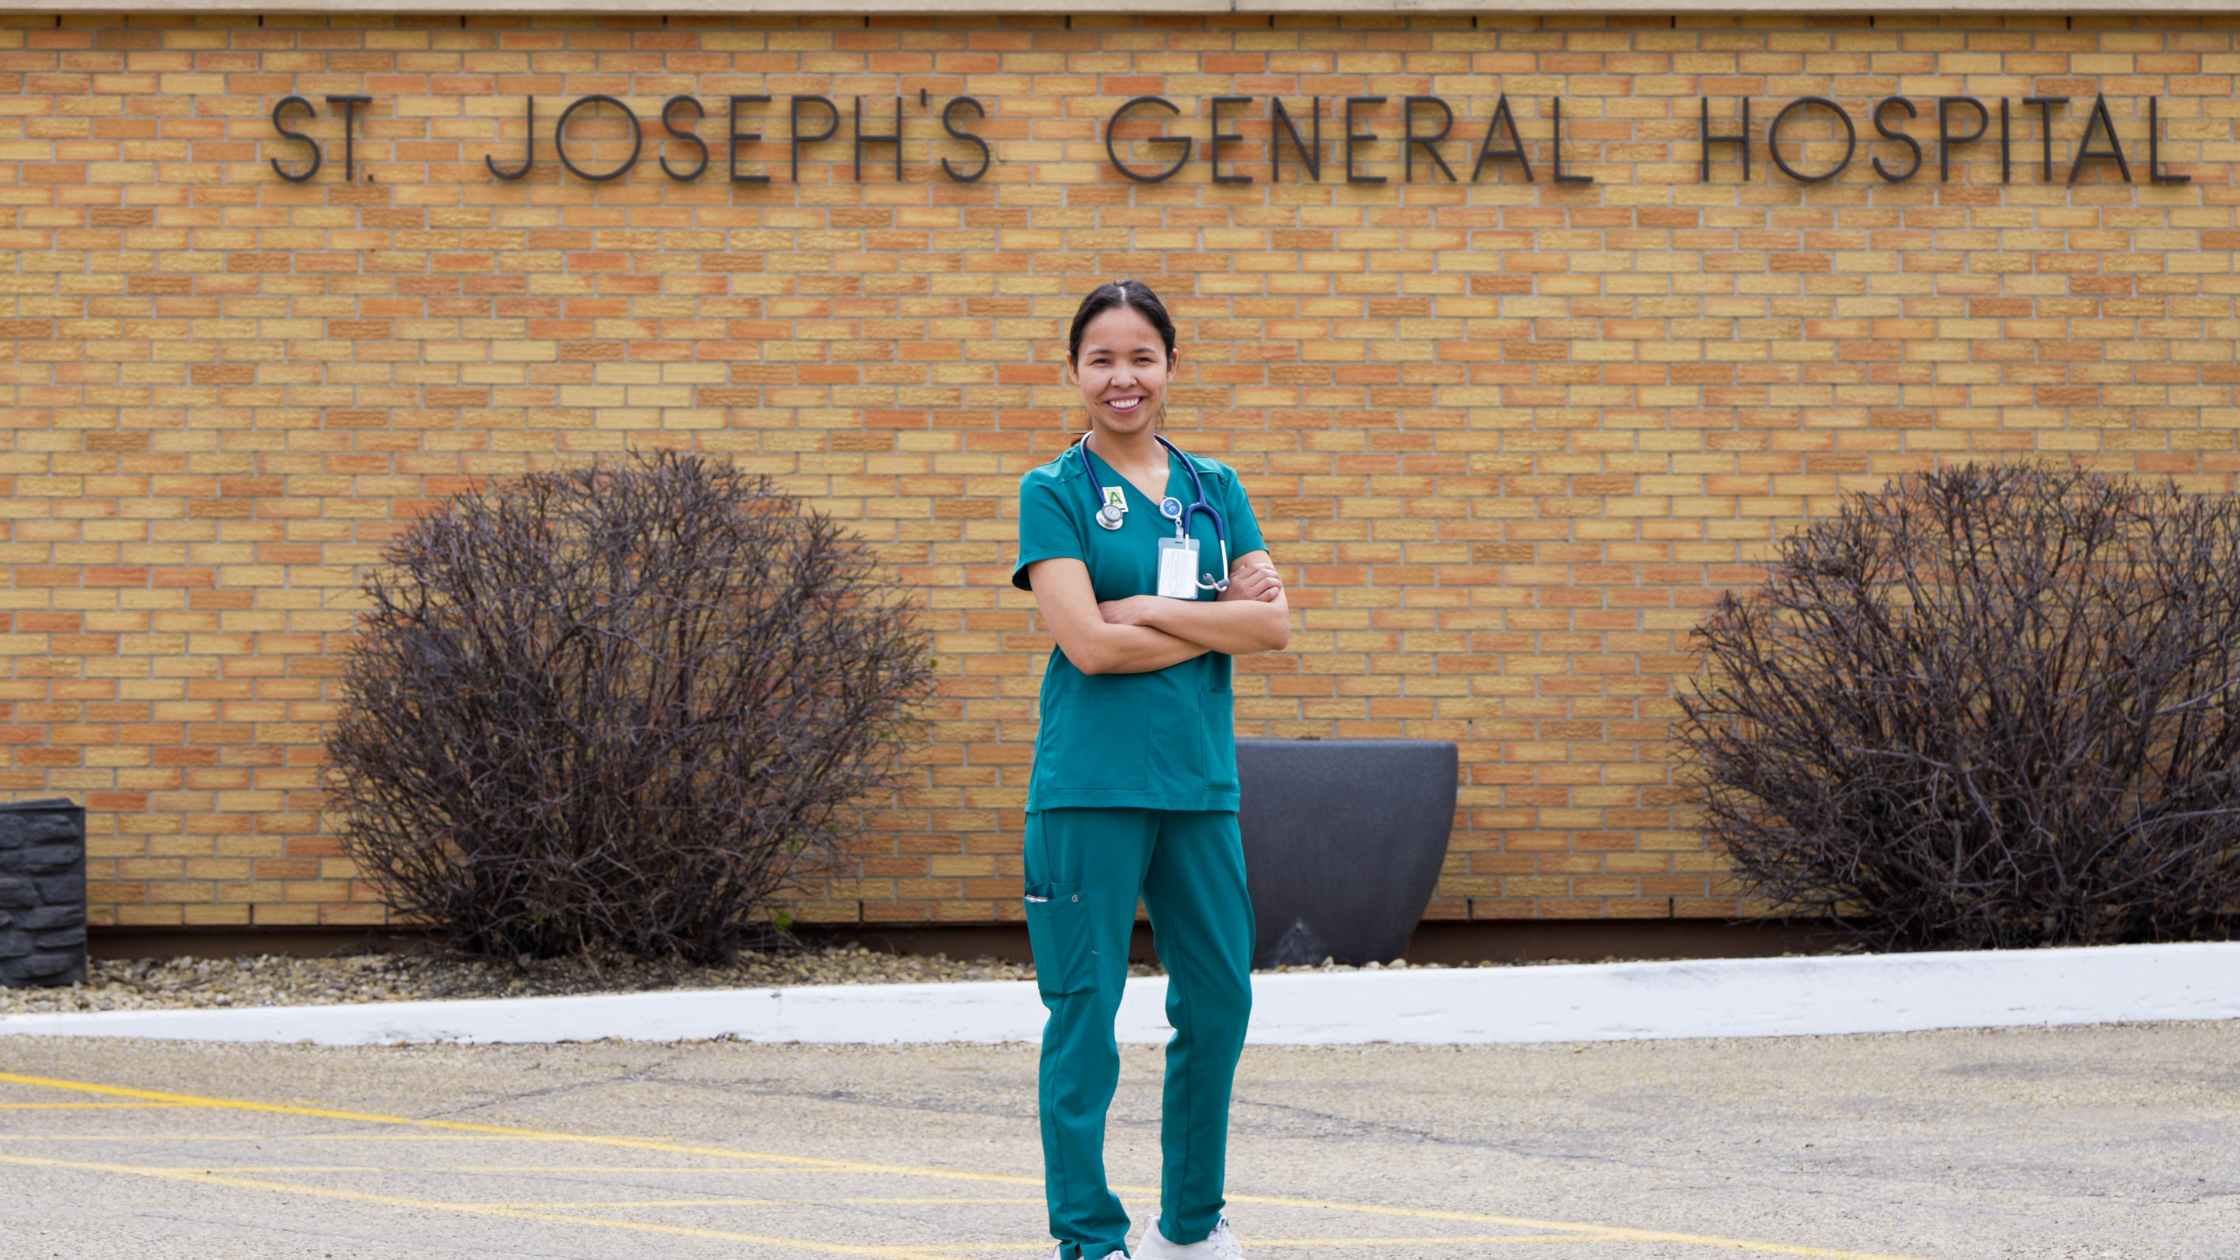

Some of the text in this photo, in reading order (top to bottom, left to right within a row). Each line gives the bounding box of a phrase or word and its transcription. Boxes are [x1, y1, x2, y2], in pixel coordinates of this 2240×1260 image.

[271, 88, 2191, 183] ST. JOSEPH'S GENERAL HOSPITAL
[1110, 491, 1123, 505] A
